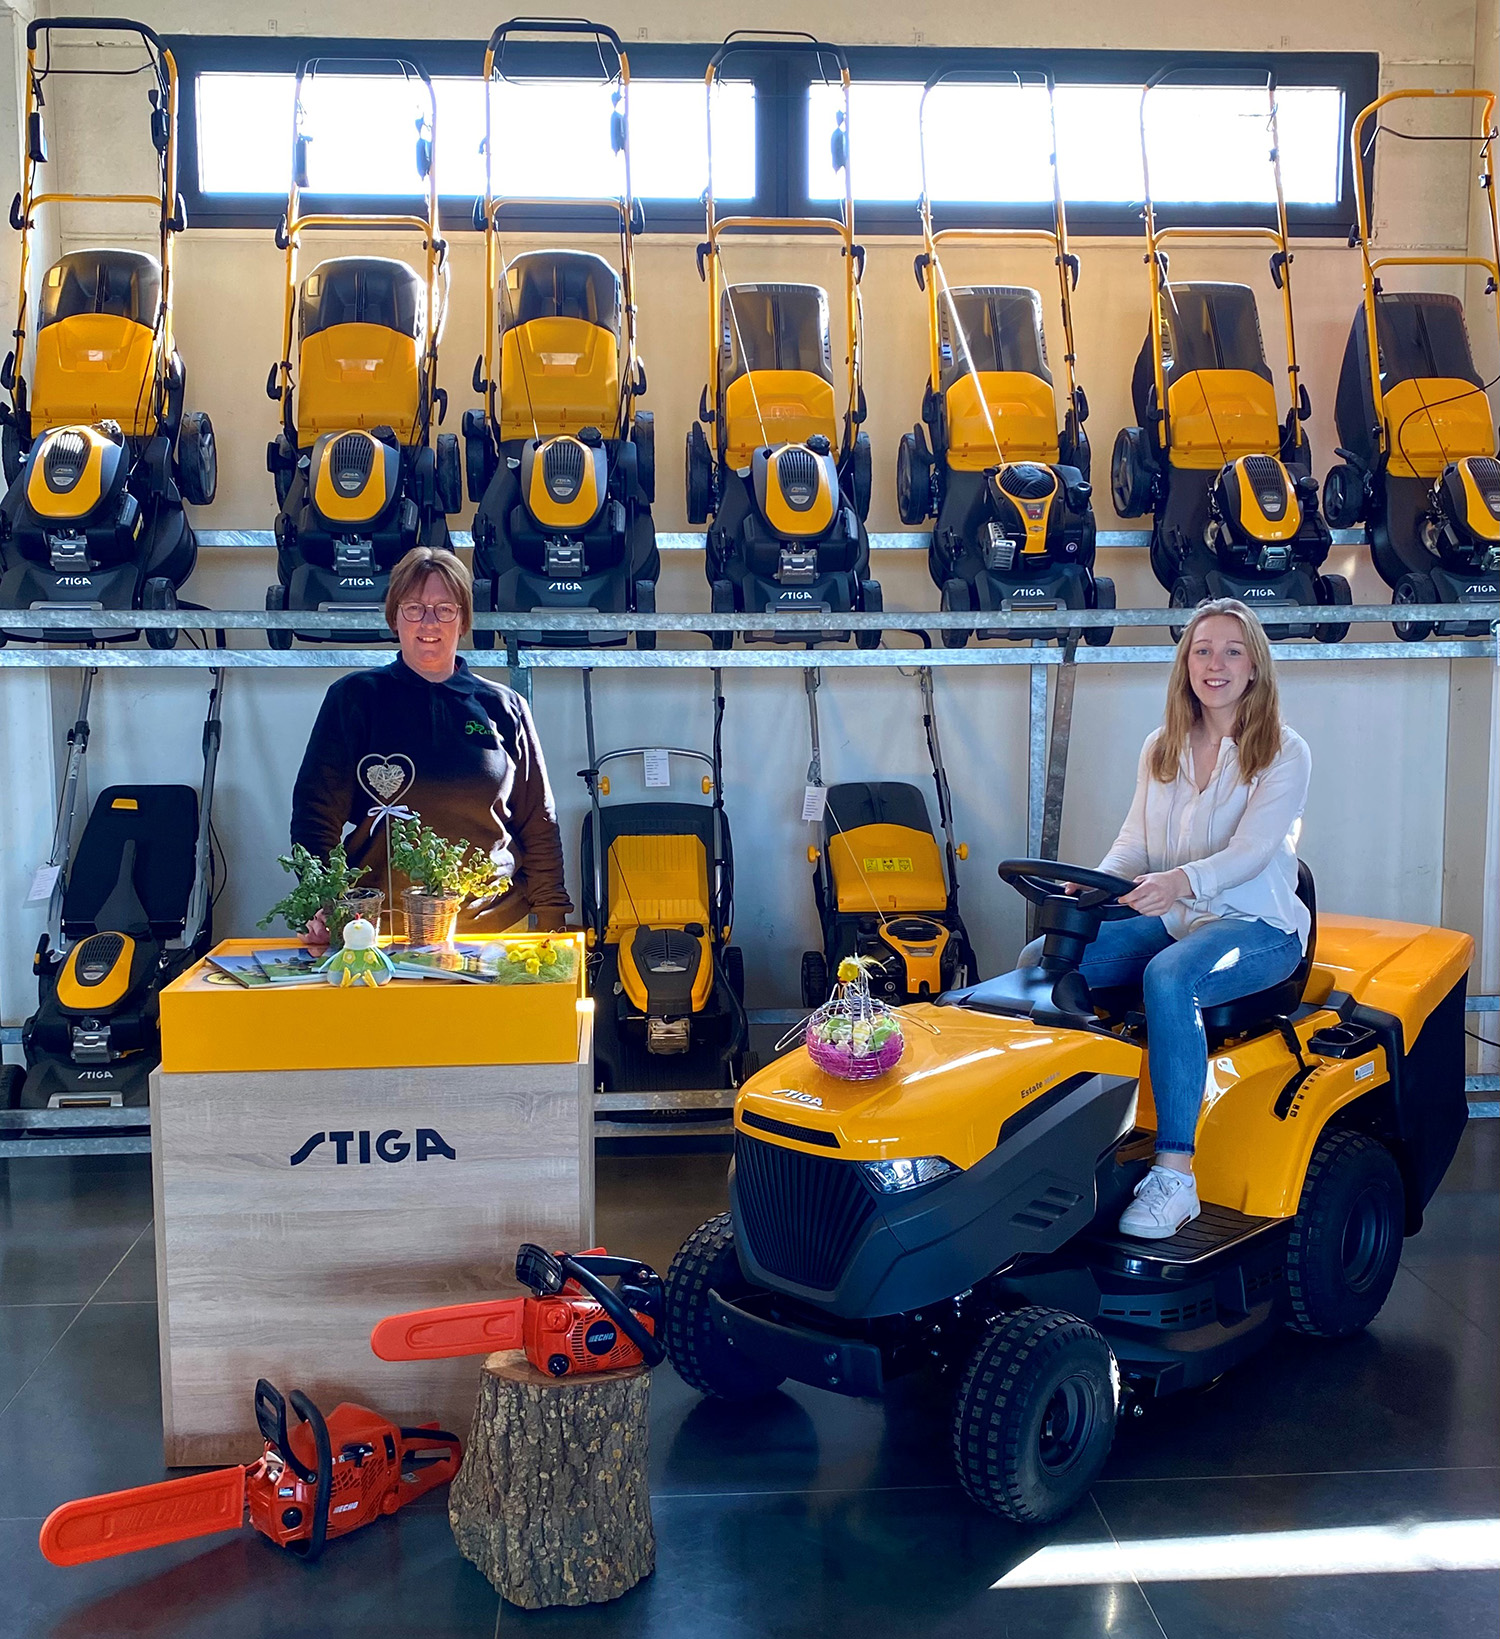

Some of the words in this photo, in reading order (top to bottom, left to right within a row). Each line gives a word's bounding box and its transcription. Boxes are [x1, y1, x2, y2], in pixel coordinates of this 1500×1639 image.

[56, 577, 92, 585] STIGA
[339, 578, 375, 586] STIGA
[548, 582, 582, 590] STIGA
[1465, 585, 1497, 593] STIGA
[779, 592, 813, 600] STIGA
[1012, 588, 1045, 597] STIGA
[1243, 589, 1276, 597] STIGA
[77, 1070, 114, 1079] STIGA
[1020, 1081, 1043, 1099] Estate
[772, 1088, 823, 1107] STIGA
[290, 1128, 456, 1166] STIGA
[591, 1332, 615, 1342] ECHO
[336, 1501, 359, 1513] ECHO
